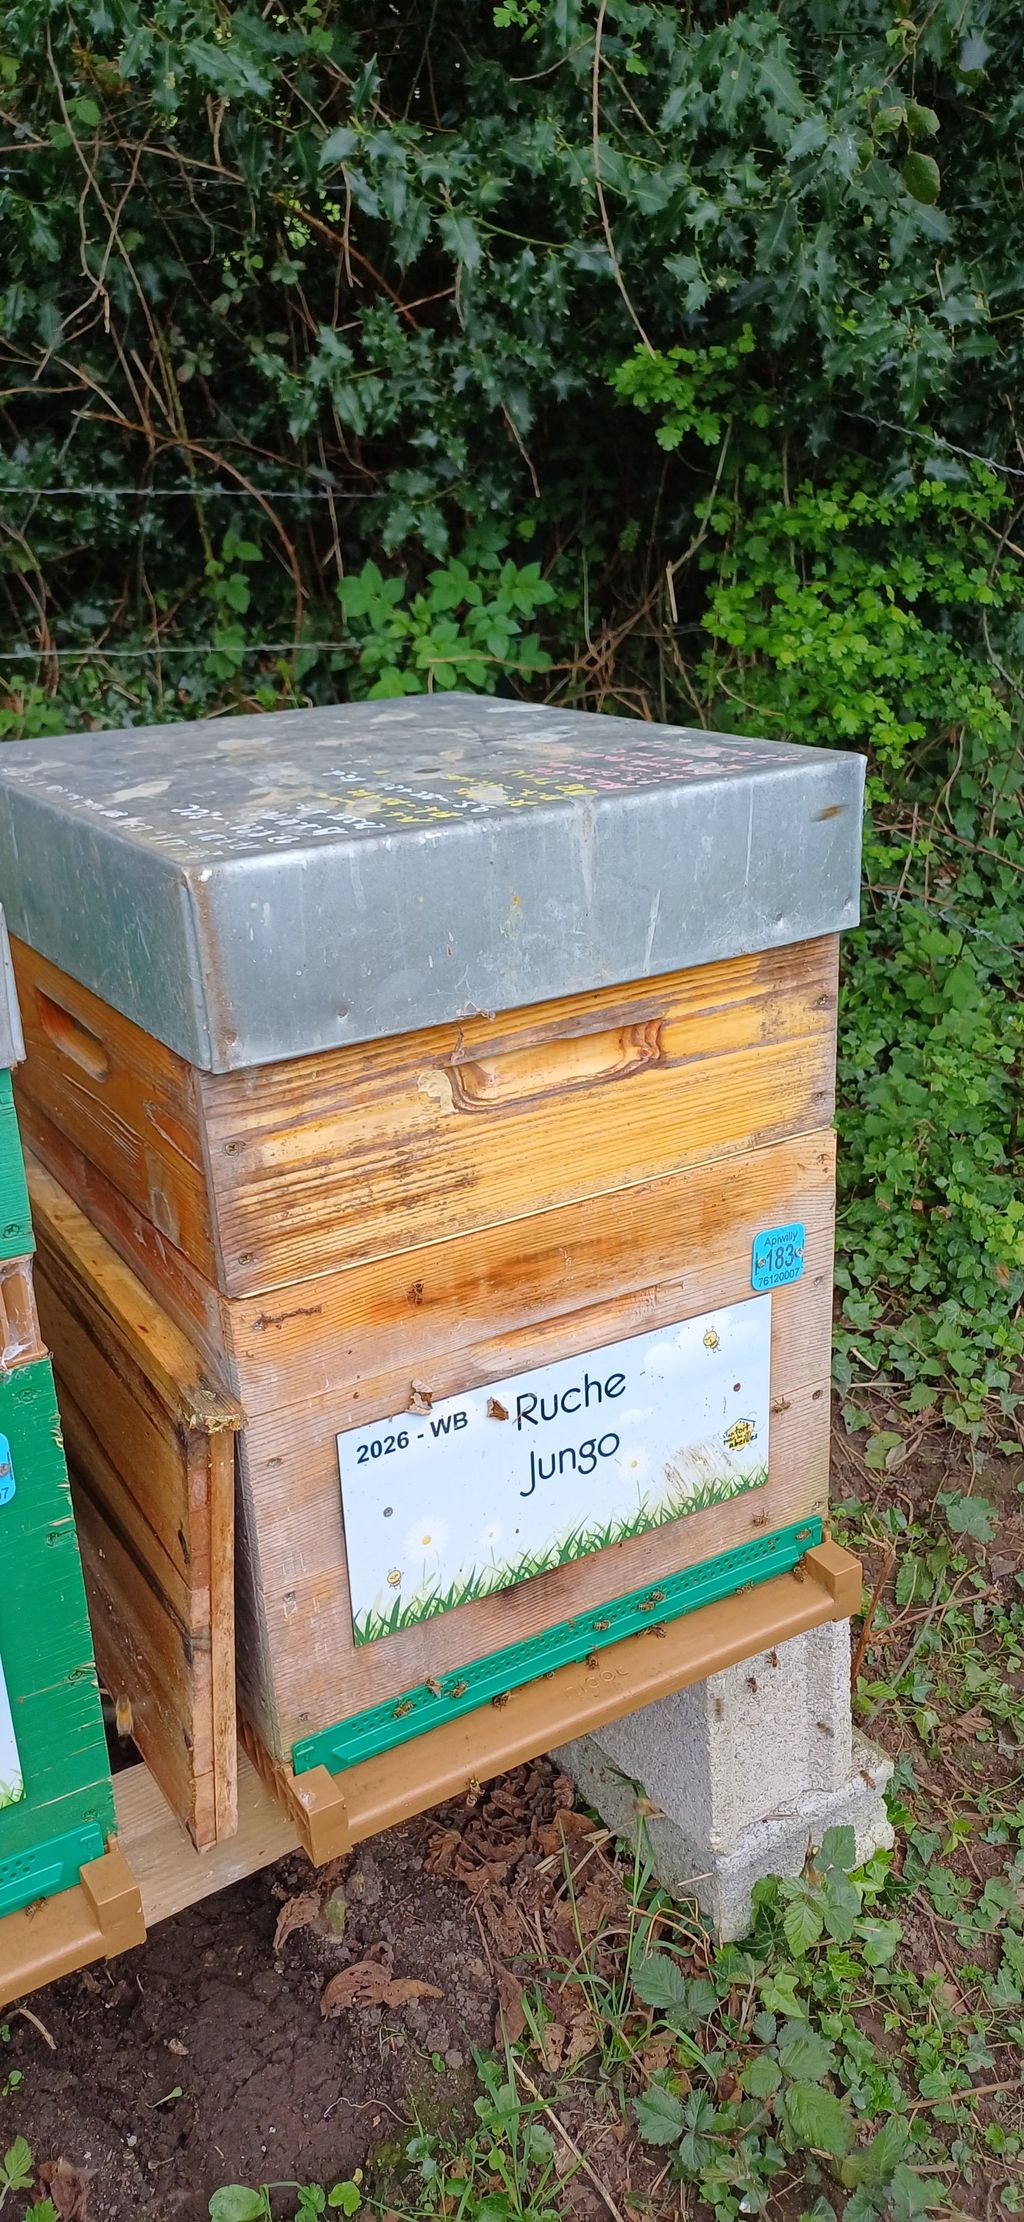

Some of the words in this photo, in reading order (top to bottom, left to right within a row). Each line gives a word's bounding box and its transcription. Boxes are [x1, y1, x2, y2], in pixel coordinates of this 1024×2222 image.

[758, 1267, 800, 1288] 76120007
[766, 1243, 795, 1272] 183
[514, 1373, 627, 1431] Ruche
[356, 1430, 410, 1464] 2026
[429, 1411, 468, 1438] WB
[519, 1431, 621, 1497] Jungo
